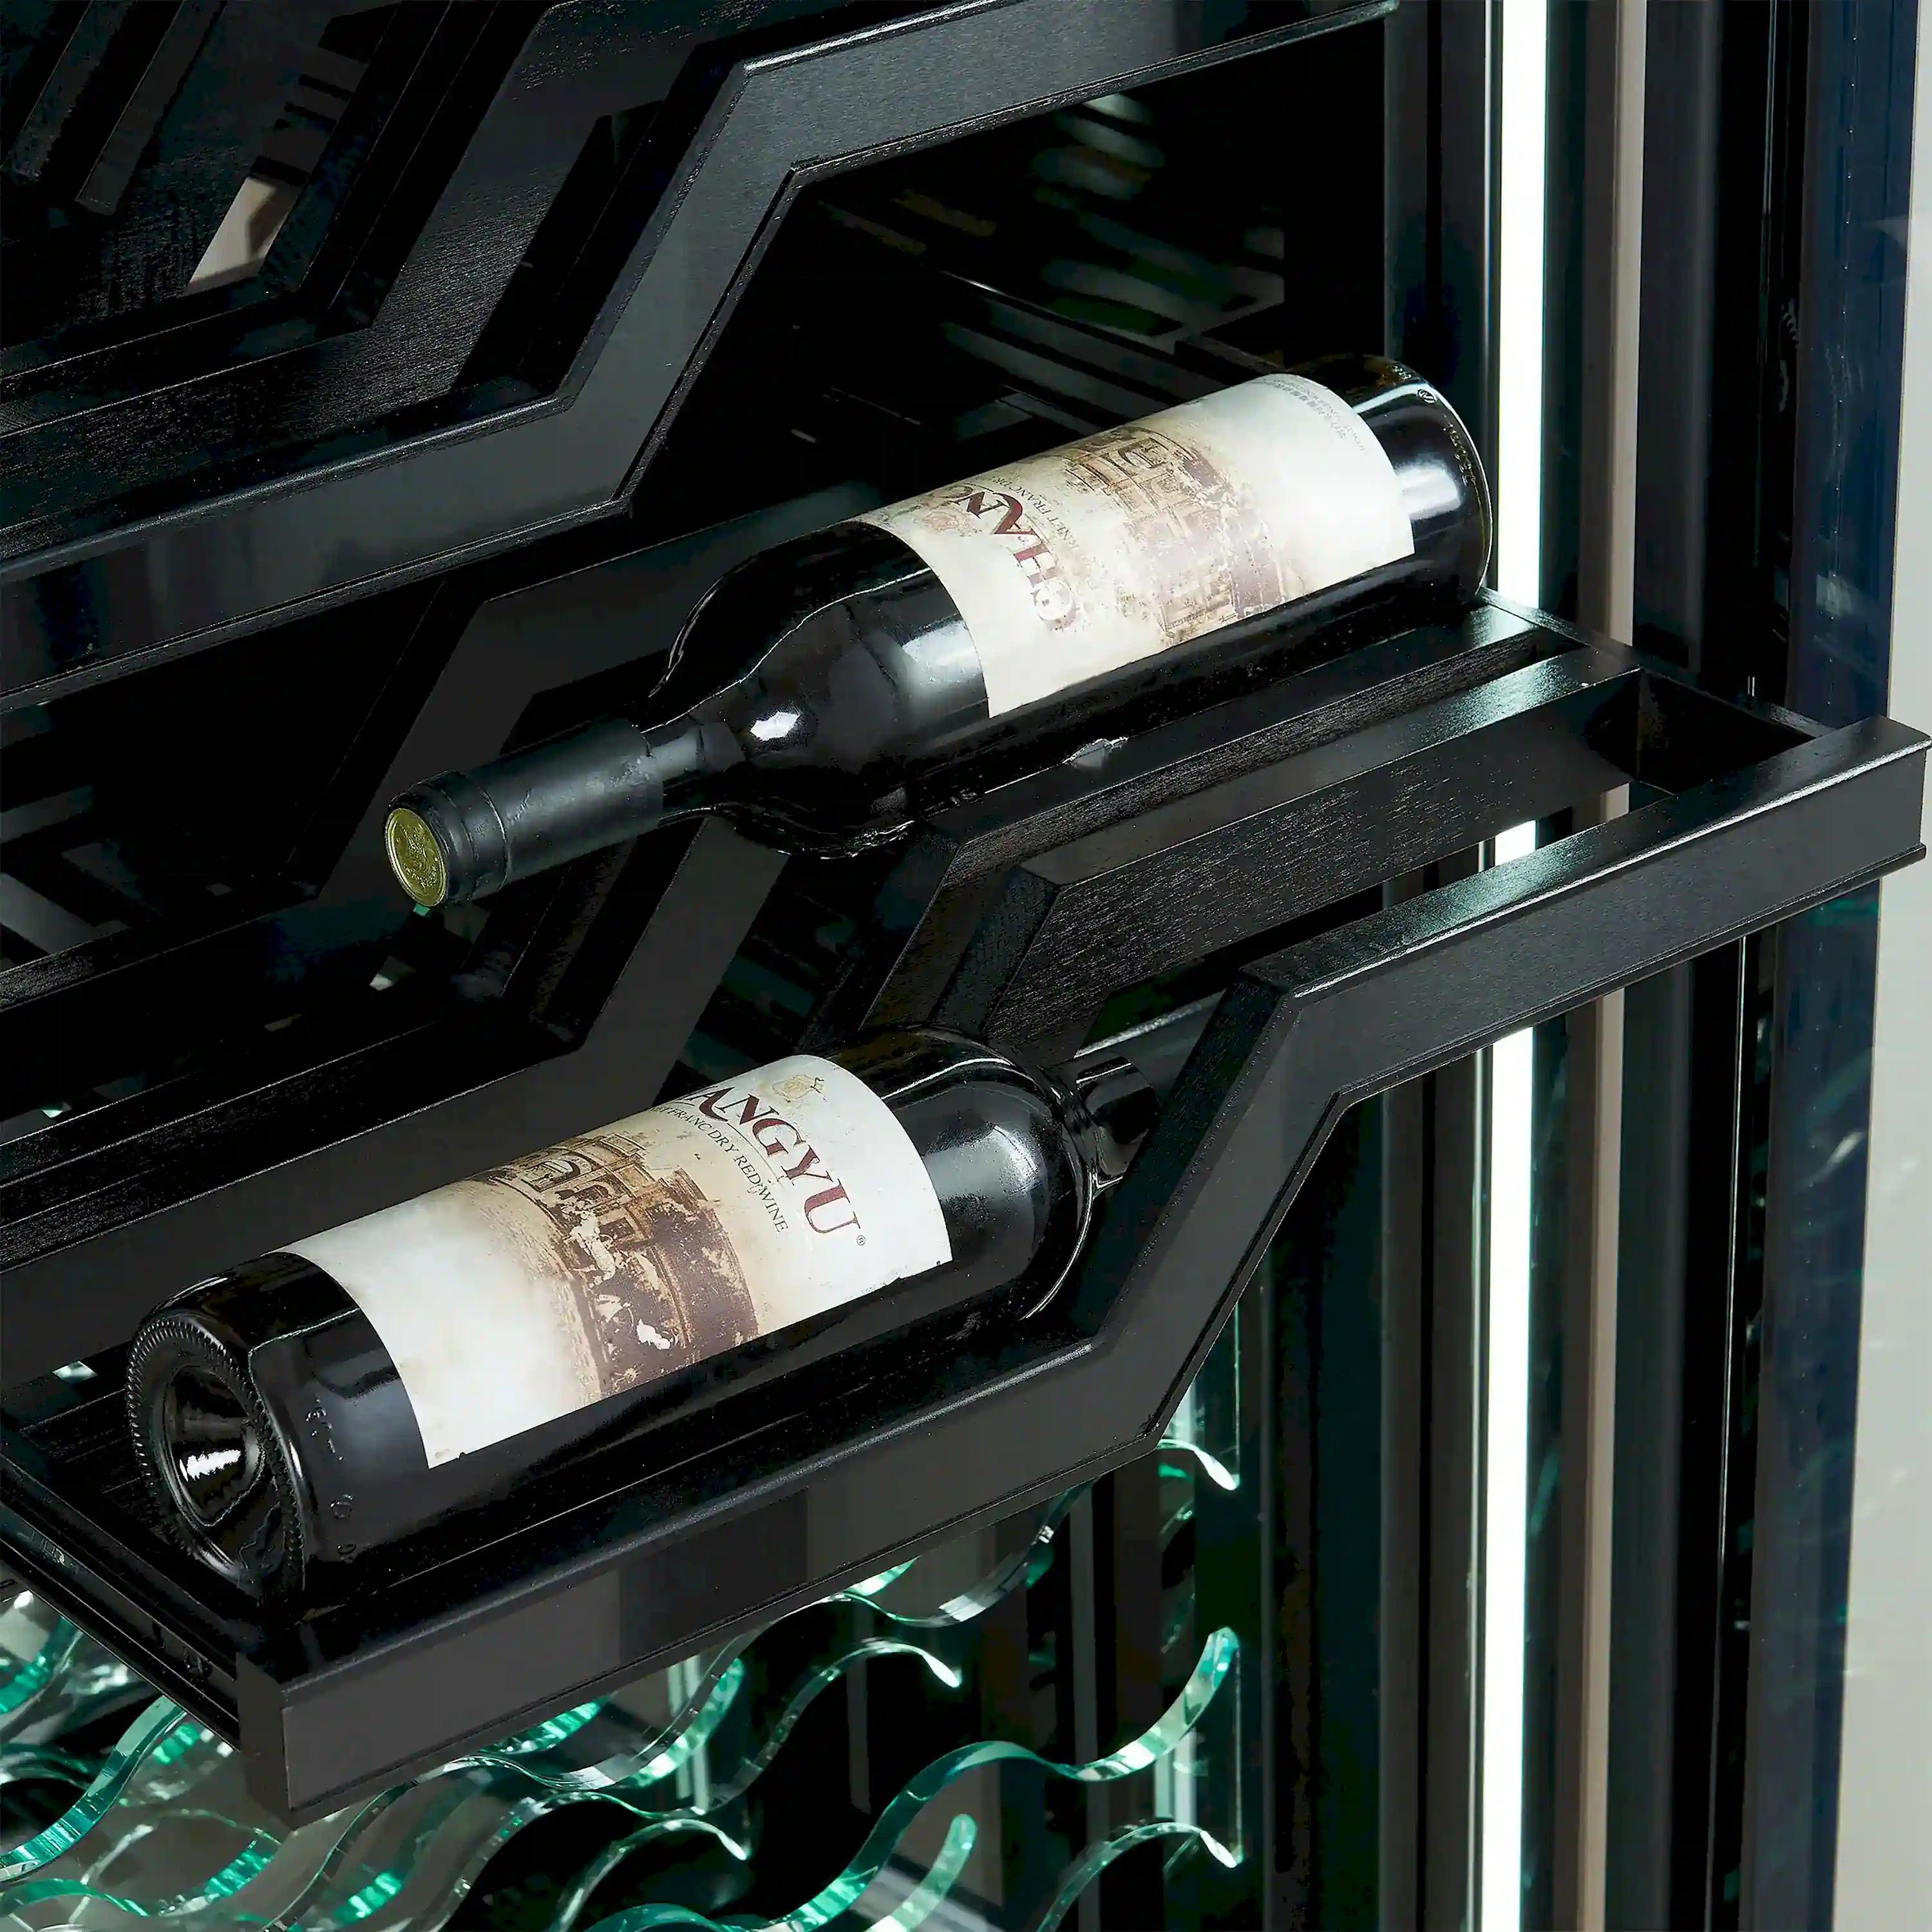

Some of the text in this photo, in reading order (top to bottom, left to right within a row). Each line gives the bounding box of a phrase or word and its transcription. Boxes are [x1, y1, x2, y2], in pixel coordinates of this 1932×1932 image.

[1009, 486, 1052, 514] FRANC
[667, 1108, 788, 1233] FRANC DRY RED WINE
[679, 1086, 860, 1234] ANGYU
